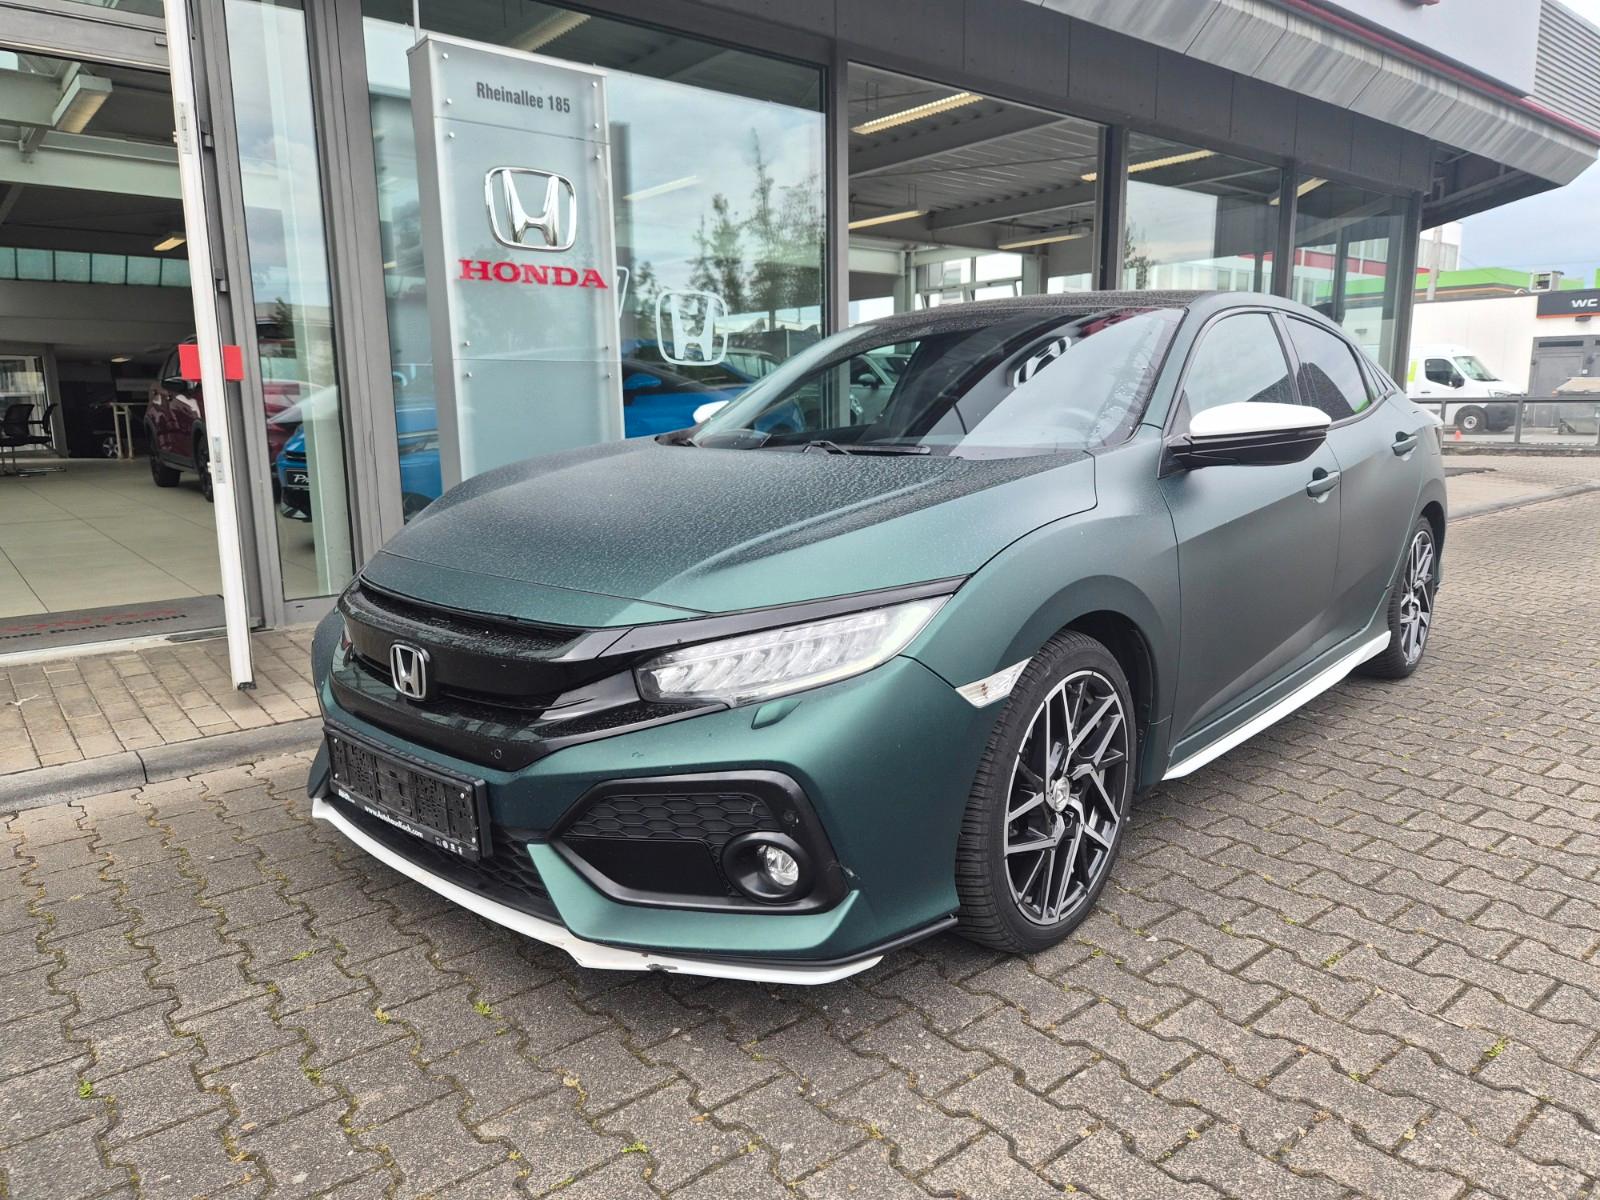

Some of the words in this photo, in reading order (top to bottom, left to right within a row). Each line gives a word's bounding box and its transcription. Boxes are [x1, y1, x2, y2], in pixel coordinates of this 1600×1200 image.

[476, 82, 544, 109] Rheinallee
[547, 95, 571, 114] 185
[458, 259, 608, 289] HONDA
